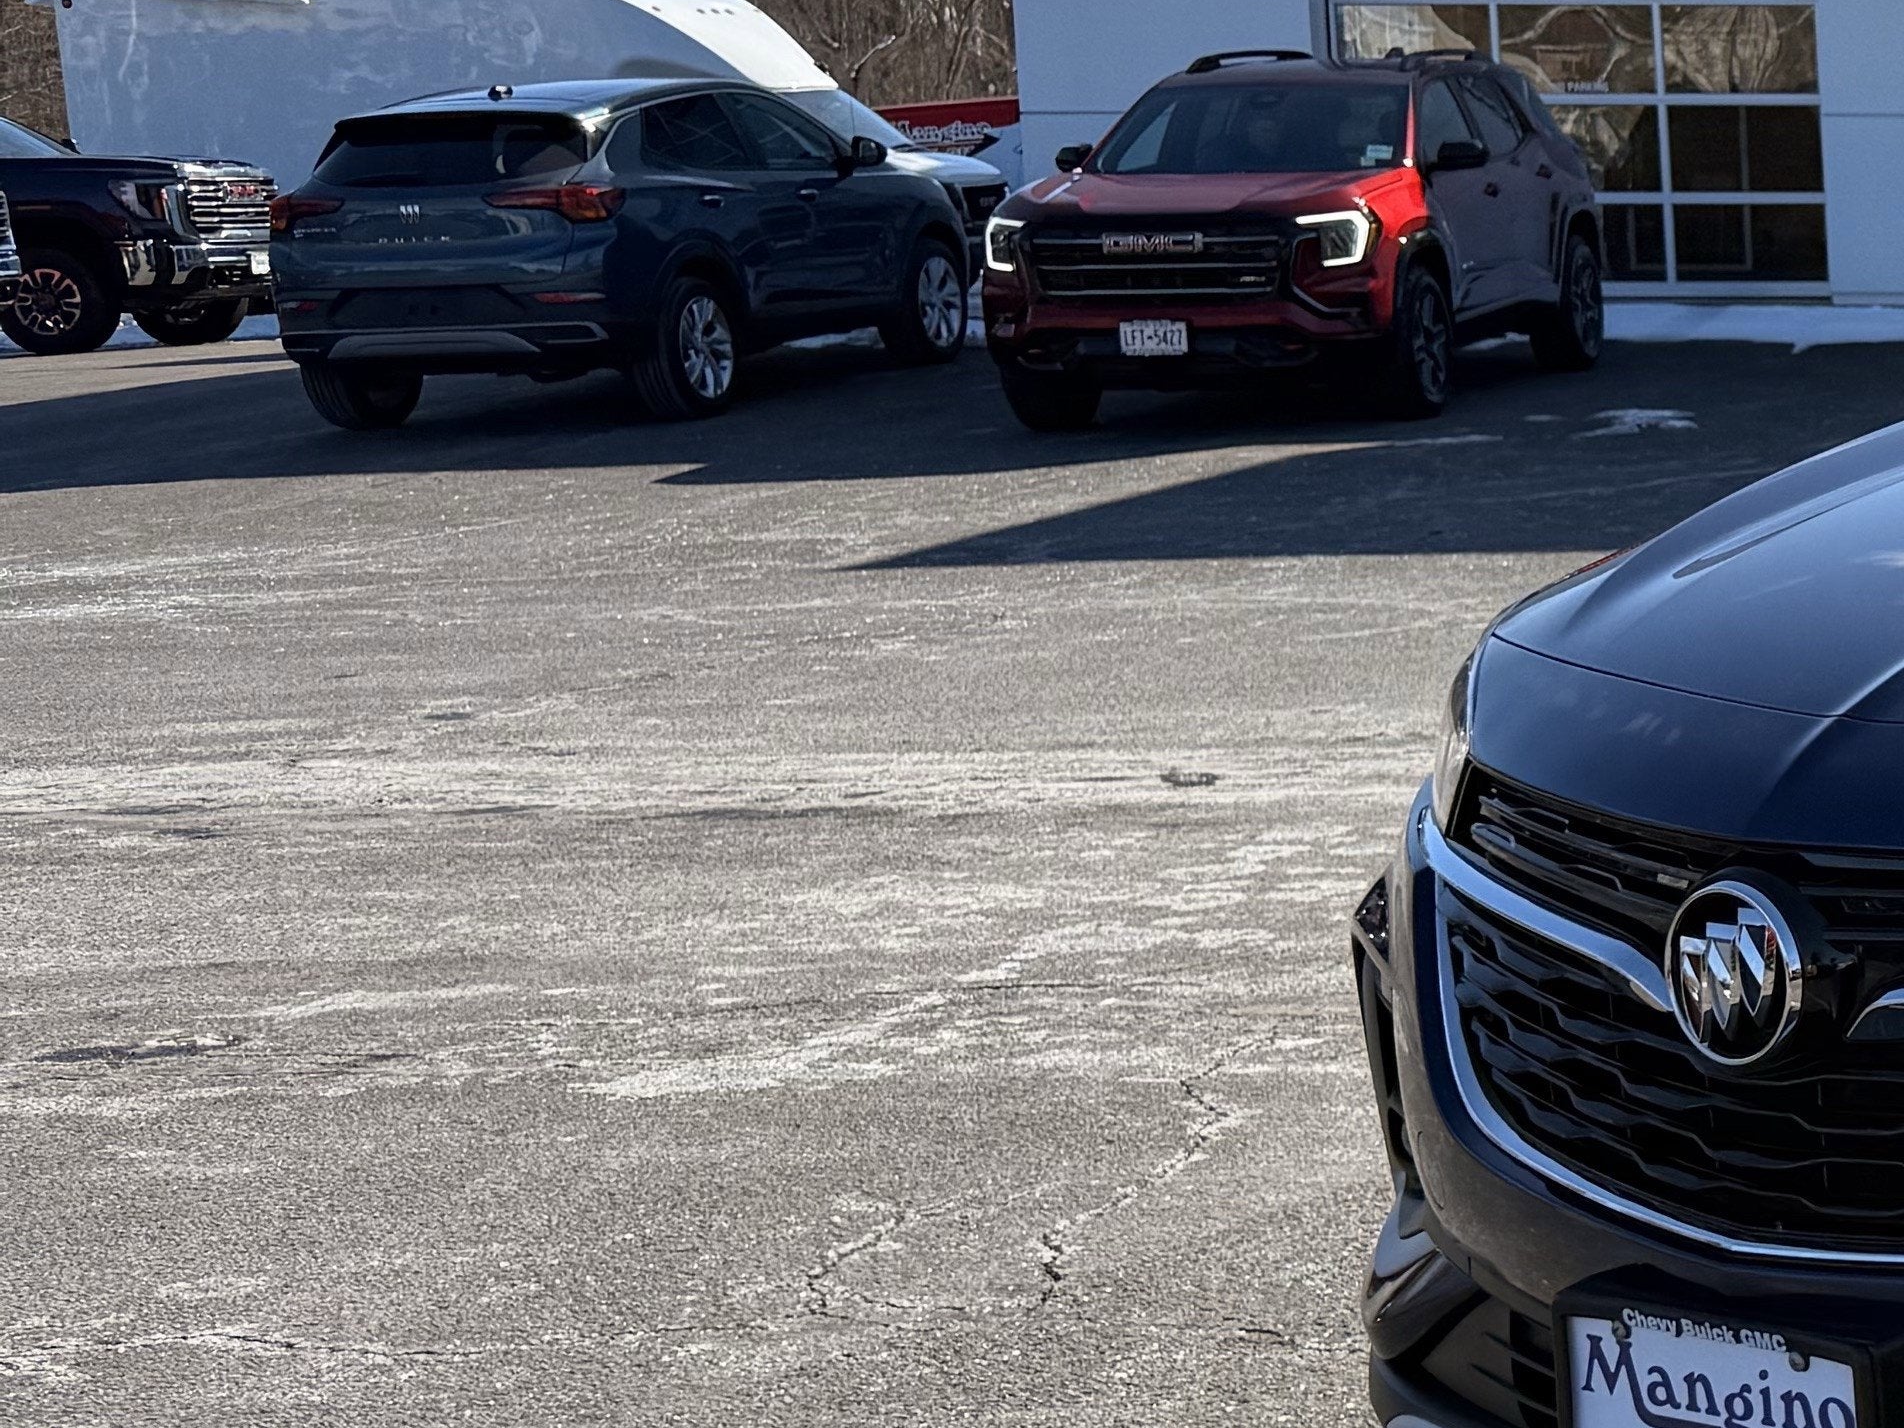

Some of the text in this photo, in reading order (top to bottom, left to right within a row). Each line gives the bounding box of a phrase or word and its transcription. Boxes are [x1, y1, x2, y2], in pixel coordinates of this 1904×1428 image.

[1622, 1308, 1787, 1353] Chevy Buick GMC
